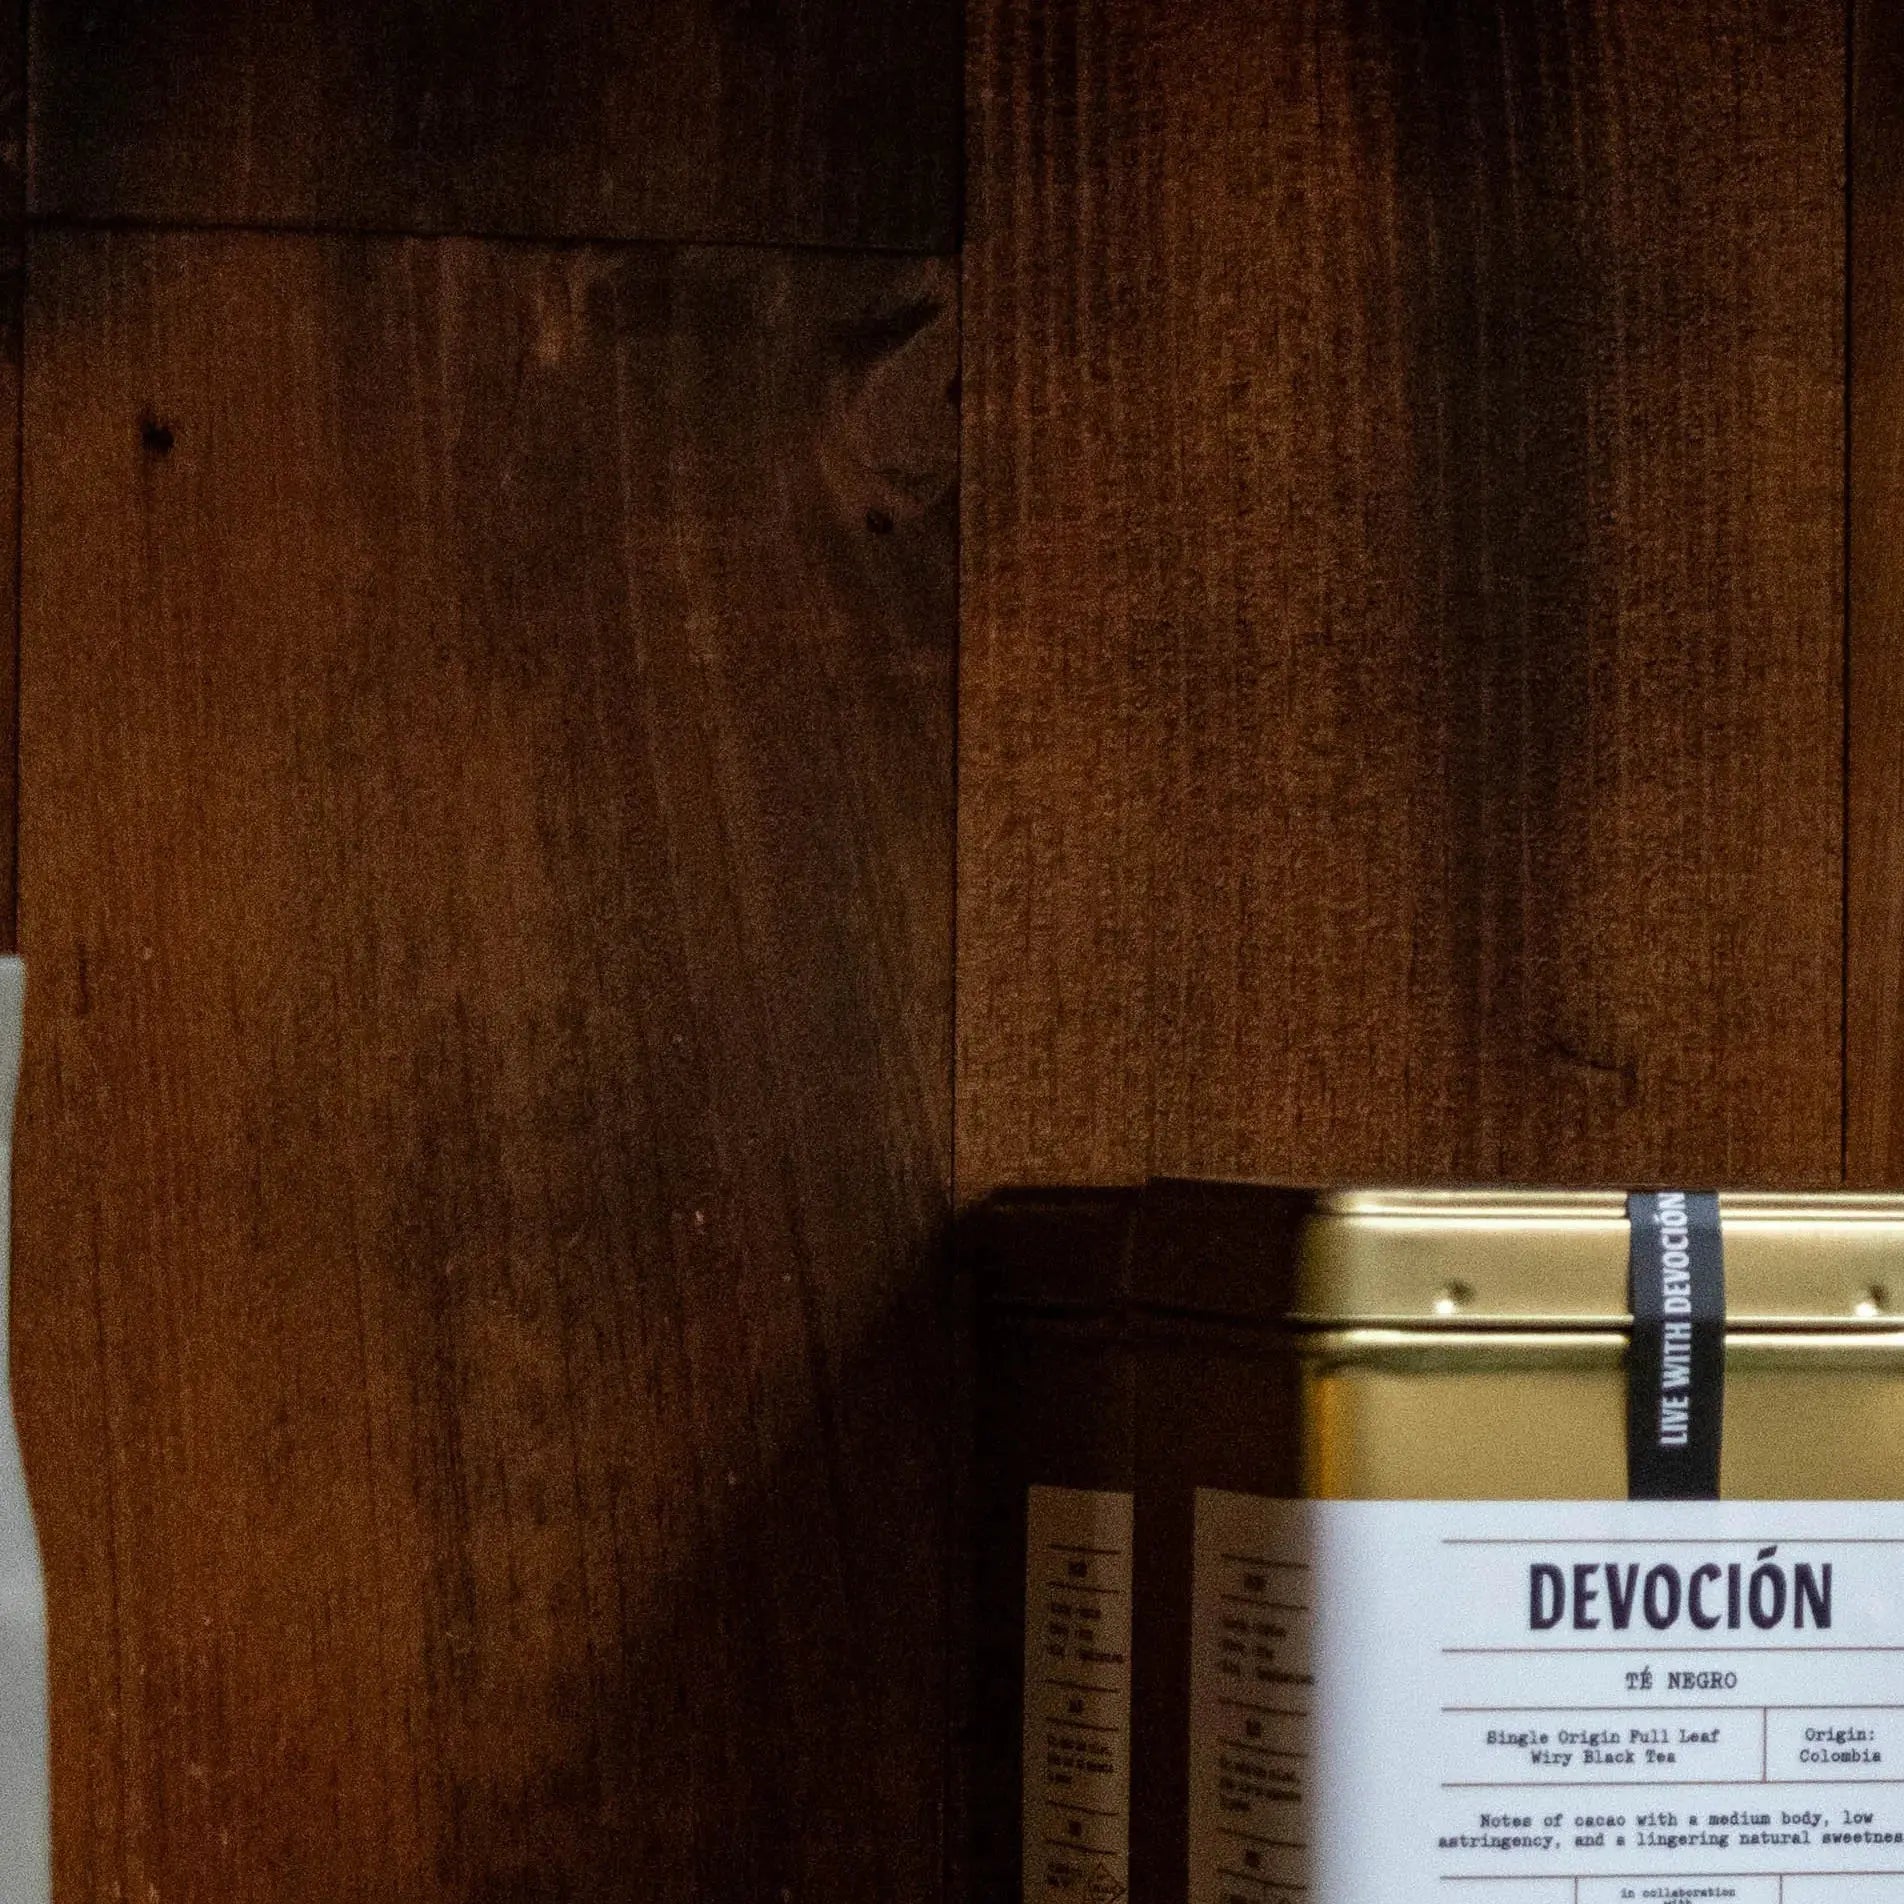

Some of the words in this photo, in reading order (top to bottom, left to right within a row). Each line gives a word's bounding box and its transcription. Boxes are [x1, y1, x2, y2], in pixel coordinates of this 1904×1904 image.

[1654, 1192, 1692, 1314] DEVOCIÓN
[1662, 1323, 1692, 1388] WITH
[1659, 1397, 1689, 1445] LIVE
[1529, 1545, 1832, 1631] DEVOCIÓN
[1625, 1665, 1653, 1691] TÉ
[1667, 1671, 1738, 1690] NEGRO
[1486, 1730, 1549, 1748] Single
[1558, 1730, 1620, 1748] Origin
[1629, 1729, 1669, 1744] Full
[1679, 1728, 1720, 1744] Leaf
[1805, 1727, 1874, 1745] Origin:
[1530, 1749, 1573, 1767] Wiry
[1583, 1748, 1635, 1764] Black
[1645, 1749, 1676, 1764] Tea
[1799, 1748, 1882, 1764] Colombia
[1480, 1814, 1532, 1829] Notes
[1543, 1813, 1563, 1828] of
[1574, 1815, 1626, 1828] cacao
[1636, 1812, 1678, 1827] with
[1689, 1815, 1698, 1826] a
[1708, 1811, 1771, 1826] medium
[1781, 1811, 1829, 1828] body,
[1843, 1810, 1874, 1825] low
[1437, 1833, 1560, 1851] astringency,
[1574, 1832, 1605, 1848] and
[1616, 1835, 1625, 1847] a
[1637, 1831, 1729, 1849] lingering
[1739, 1830, 1811, 1845] natural
